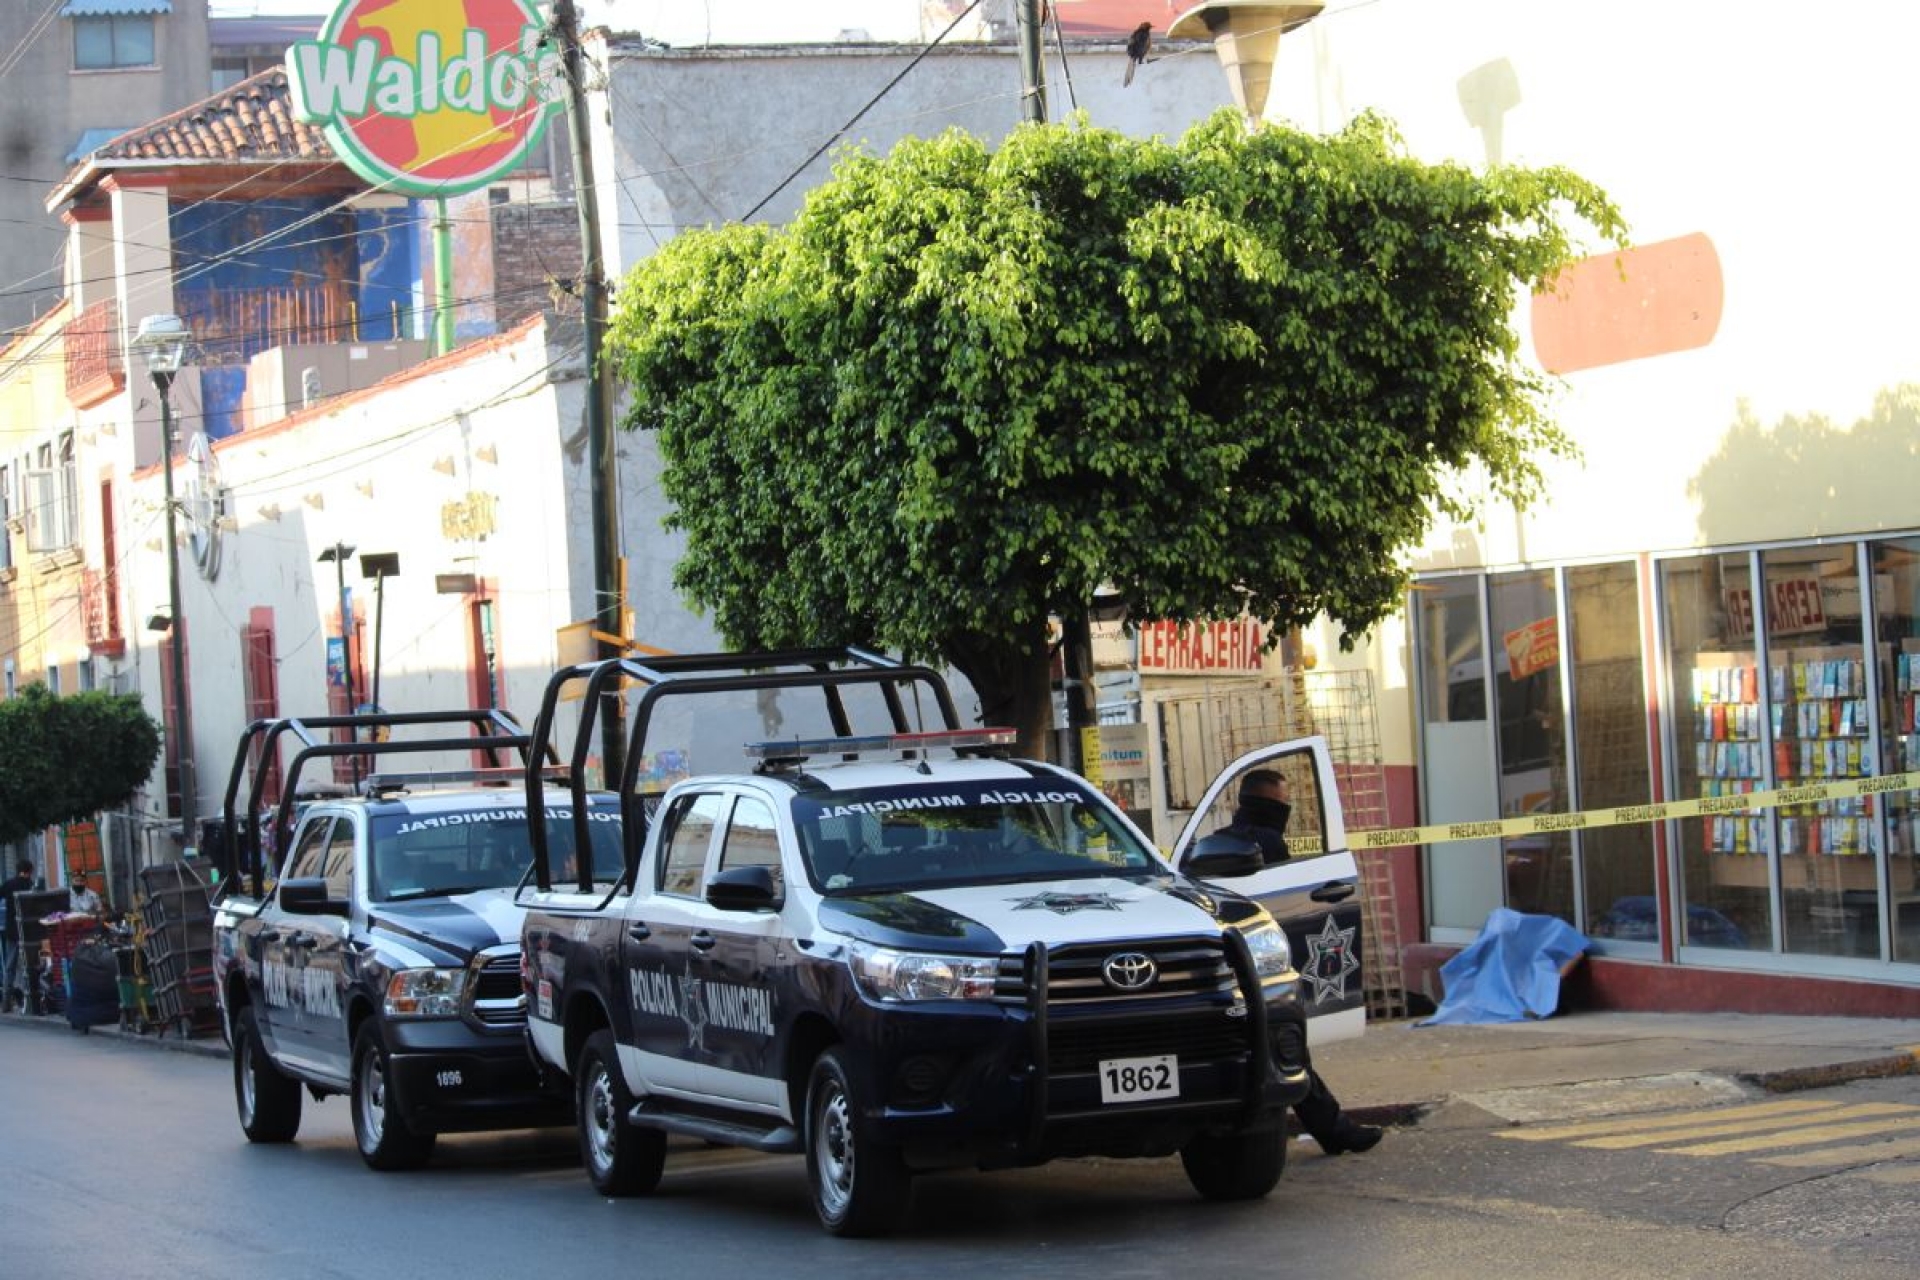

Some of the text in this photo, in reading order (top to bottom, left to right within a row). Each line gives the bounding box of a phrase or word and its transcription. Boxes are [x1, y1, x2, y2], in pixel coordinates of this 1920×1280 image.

[1449, 822, 1503, 838] PRECAUCION
[1534, 814, 1586, 830] PRECAUCION
[1367, 829, 1420, 846] PRECAUCION
[630, 963, 775, 1036] POLICÍA MUNICIPAL
[1106, 1064, 1172, 1094] 1862
